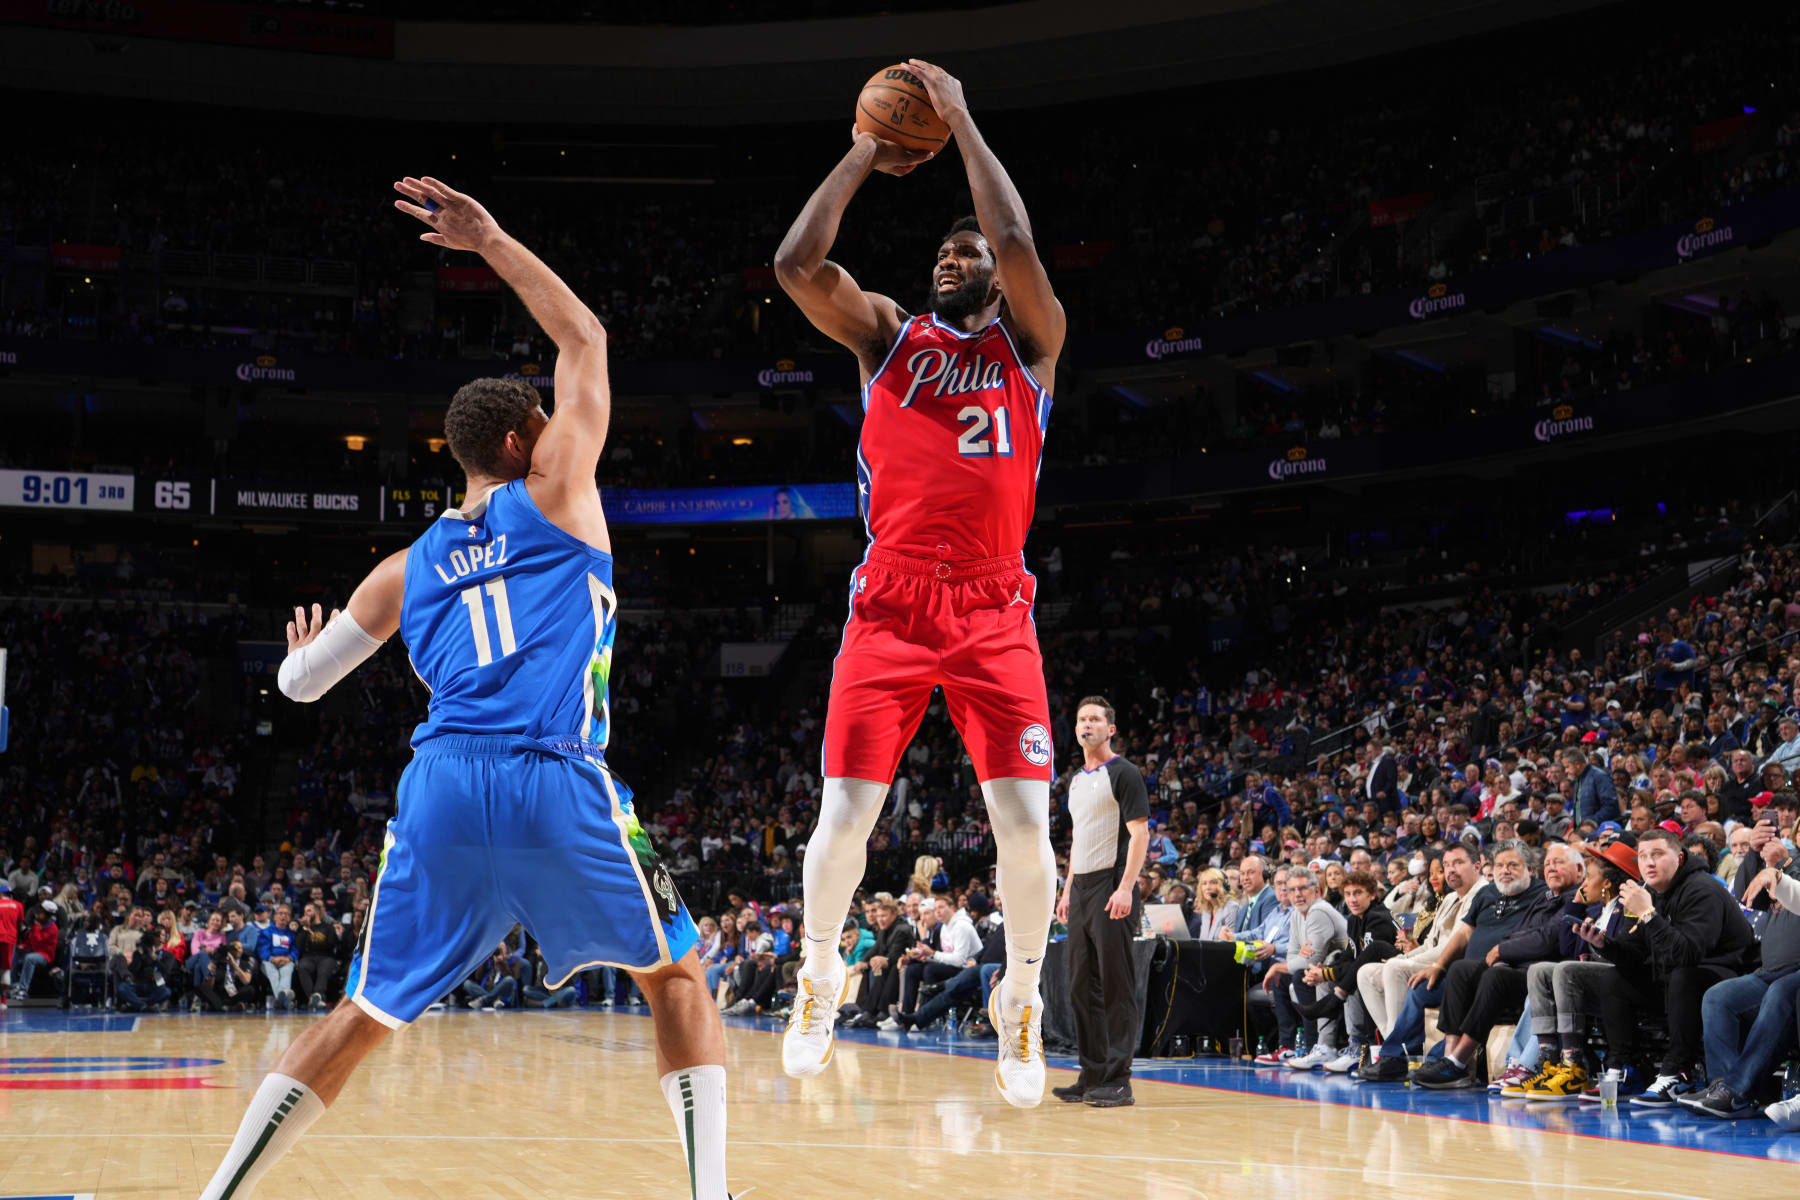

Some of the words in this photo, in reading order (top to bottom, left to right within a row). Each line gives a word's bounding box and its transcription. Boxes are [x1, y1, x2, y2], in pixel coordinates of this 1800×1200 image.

[104, 0, 136, 20] Go
[1677, 226, 1733, 257] Corona
[1409, 292, 1466, 319] Corona
[1146, 338, 1202, 360] Corona
[236, 362, 296, 383] Corona
[758, 368, 814, 388] Corona
[899, 348, 1005, 408] Phila
[957, 406, 1013, 457] 21
[1534, 416, 1594, 442] Corona
[1268, 458, 1327, 480] Corona
[22, 475, 89, 505] 9:01
[99, 486, 125, 499] 3RD
[155, 481, 190, 509] 65
[237, 490, 308, 509] MILWAUKEE
[313, 493, 359, 511] BUCKS
[392, 490, 410, 501] FLS
[420, 489, 440, 501] TOL
[397, 503, 405, 517] 1
[424, 503, 435, 517] 5
[434, 534, 508, 584] LOPEZ
[461, 575, 517, 667] 11
[243, 660, 263, 672] 119
[726, 663, 745, 673] 118
